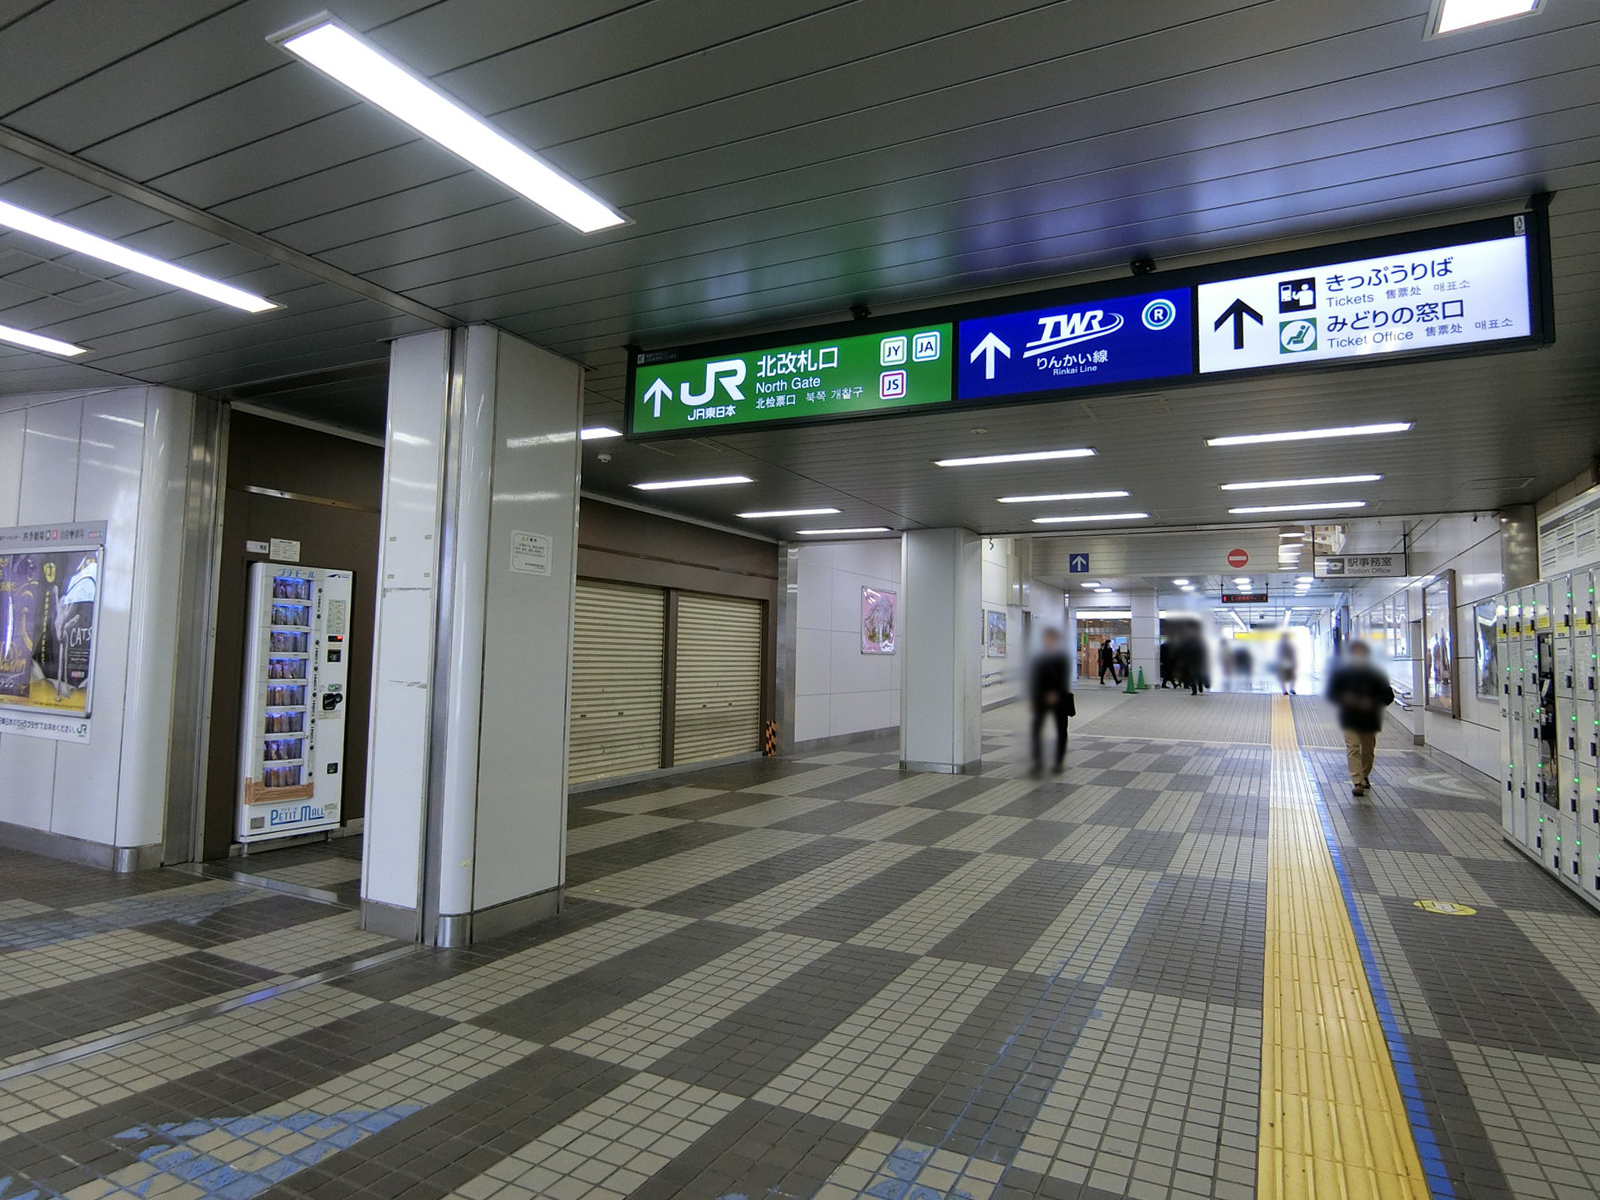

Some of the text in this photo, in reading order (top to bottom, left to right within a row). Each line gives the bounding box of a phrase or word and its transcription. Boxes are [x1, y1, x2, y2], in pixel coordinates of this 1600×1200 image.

[1326, 256, 1454, 292] きっぷうりば
[1326, 279, 1471, 307] Tickets 售票处 매표소
[1153, 309, 1164, 321] R
[1327, 299, 1464, 332] みどりの窓口
[1036, 310, 1104, 343] TWR
[1327, 317, 1514, 348] Ticket Office 售票处 매표소
[886, 340, 934, 358] JY JA
[1036, 349, 1109, 370] りんかい線
[756, 347, 838, 378] 北改札口
[1052, 365, 1098, 376] Rinkai Line
[680, 359, 747, 406] JR
[756, 376, 821, 395] North Gate
[886, 378, 900, 391] JS
[755, 386, 864, 410] 北检票口 북쪽 개찰구
[687, 404, 737, 421] JR東日本
[1347, 556, 1392, 568] 駅事務室
[70, 626, 92, 647] CATS
